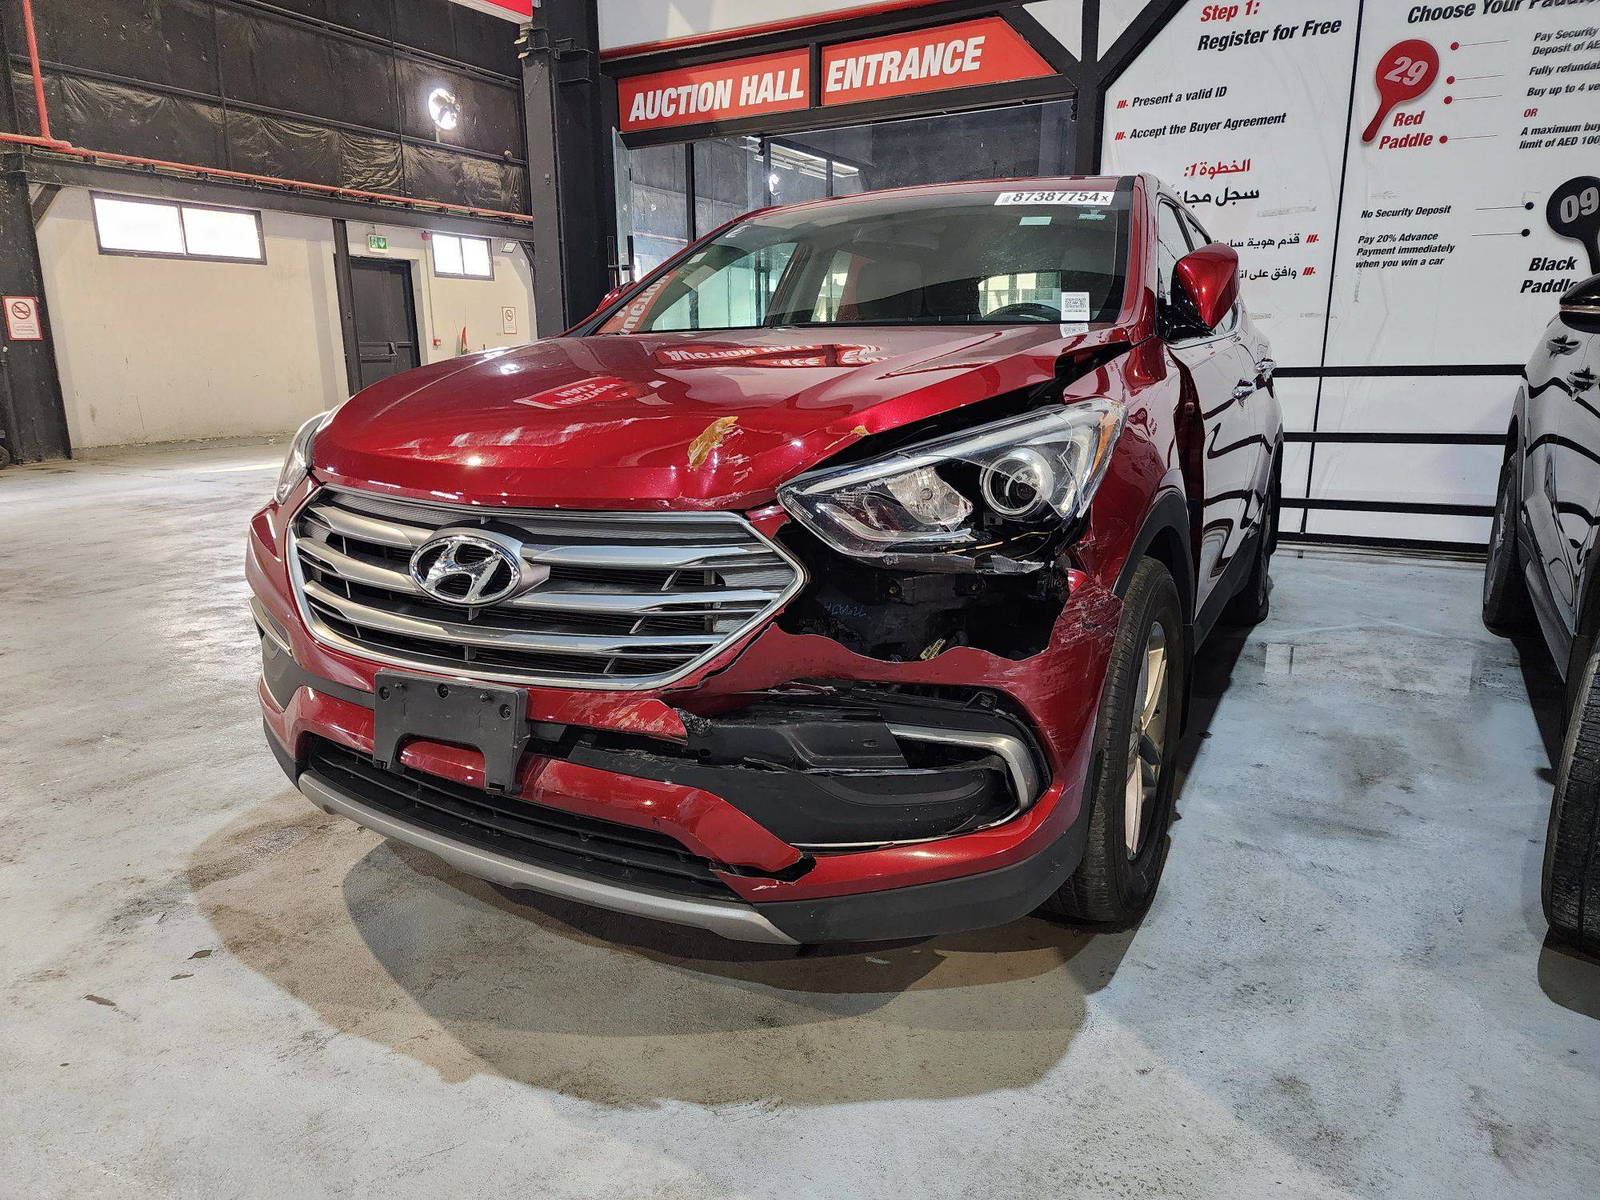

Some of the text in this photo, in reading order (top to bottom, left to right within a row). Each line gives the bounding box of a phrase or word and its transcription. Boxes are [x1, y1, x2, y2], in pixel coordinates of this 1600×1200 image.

[1200, 0, 1260, 22] Step 1:
[1408, 2, 1476, 23] Choose
[1483, 0, 1522, 14] Your
[1197, 19, 1342, 51] Register for Free
[1534, 26, 1600, 42] Pay Security
[1532, 39, 1600, 56] Deposit of AE
[826, 36, 985, 92] ENTRANCE
[1384, 56, 1429, 86] 29
[1529, 64, 1555, 76] Fully
[629, 67, 805, 122] AUCTION HALL
[1132, 85, 1228, 107] Present a valid ID
[1527, 82, 1600, 97] Buy up to 4 ve
[1393, 110, 1426, 127] Red
[1523, 108, 1539, 118] OR
[1130, 112, 1287, 139] Accept the Buyer Agreement
[1521, 122, 1600, 136] A maximum buy
[1379, 132, 1434, 150] Paddle
[1519, 140, 1544, 150] limit
[1545, 138, 1557, 149] of
[1557, 136, 1579, 147] AED
[1215, 187, 1260, 207] سجل
[1560, 187, 1600, 224] 09
[1361, 204, 1451, 219] No Security Deposit
[1358, 232, 1439, 245] Pay 20% Advance
[1356, 243, 1456, 257] Payment immediately
[1355, 257, 1445, 269] when you win a car
[1528, 256, 1579, 272] Black
